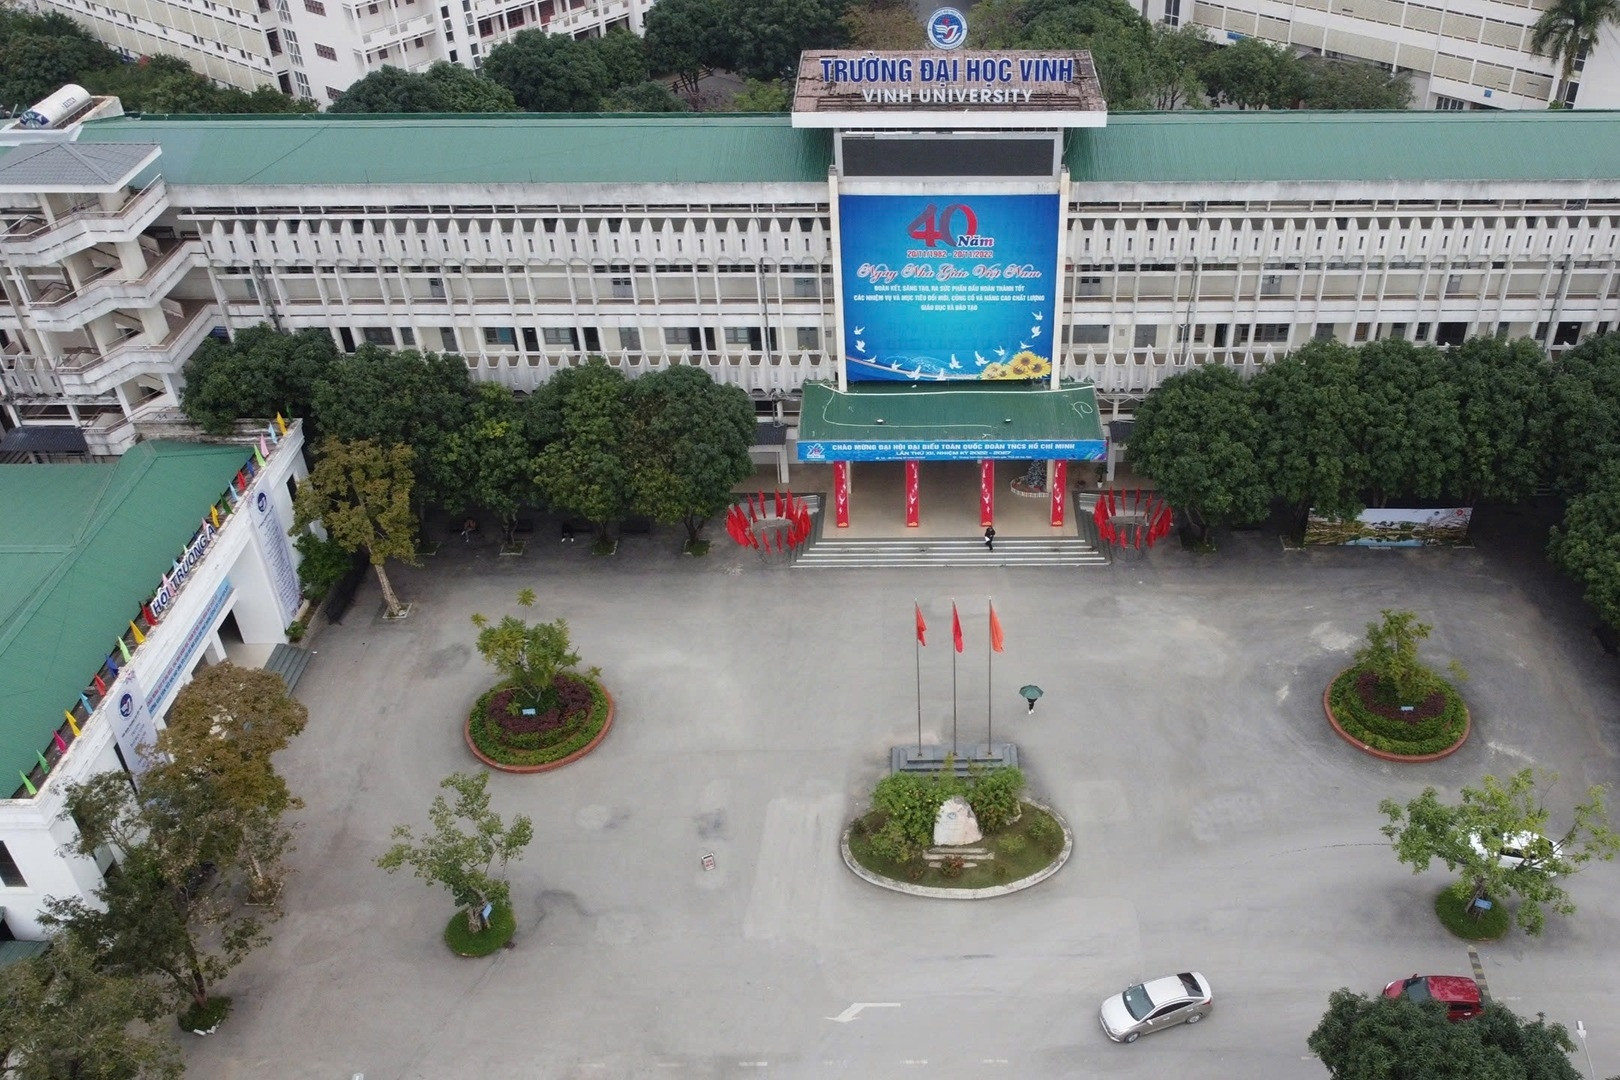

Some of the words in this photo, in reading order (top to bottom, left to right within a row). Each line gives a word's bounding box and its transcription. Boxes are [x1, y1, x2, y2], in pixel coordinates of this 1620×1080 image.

[820, 51, 912, 83] TRƯỜNG
[920, 58, 958, 87] ĐẠI
[966, 57, 1012, 87] HỌC
[1019, 57, 1074, 83] VINH
[862, 88, 912, 103] VINH
[919, 88, 1033, 103] UNIVERSITY
[907, 203, 978, 248] 40
[957, 235, 995, 248] Năm
[906, 250, 947, 259] 20/11/1982
[952, 250, 993, 259] 20/11/2022
[1003, 263, 1042, 279] Nam
[832, 443, 852, 451] CHÀO
[854, 443, 876, 451] MỪNG
[963, 442, 982, 450] QUỐC
[207, 524, 215, 540] A
